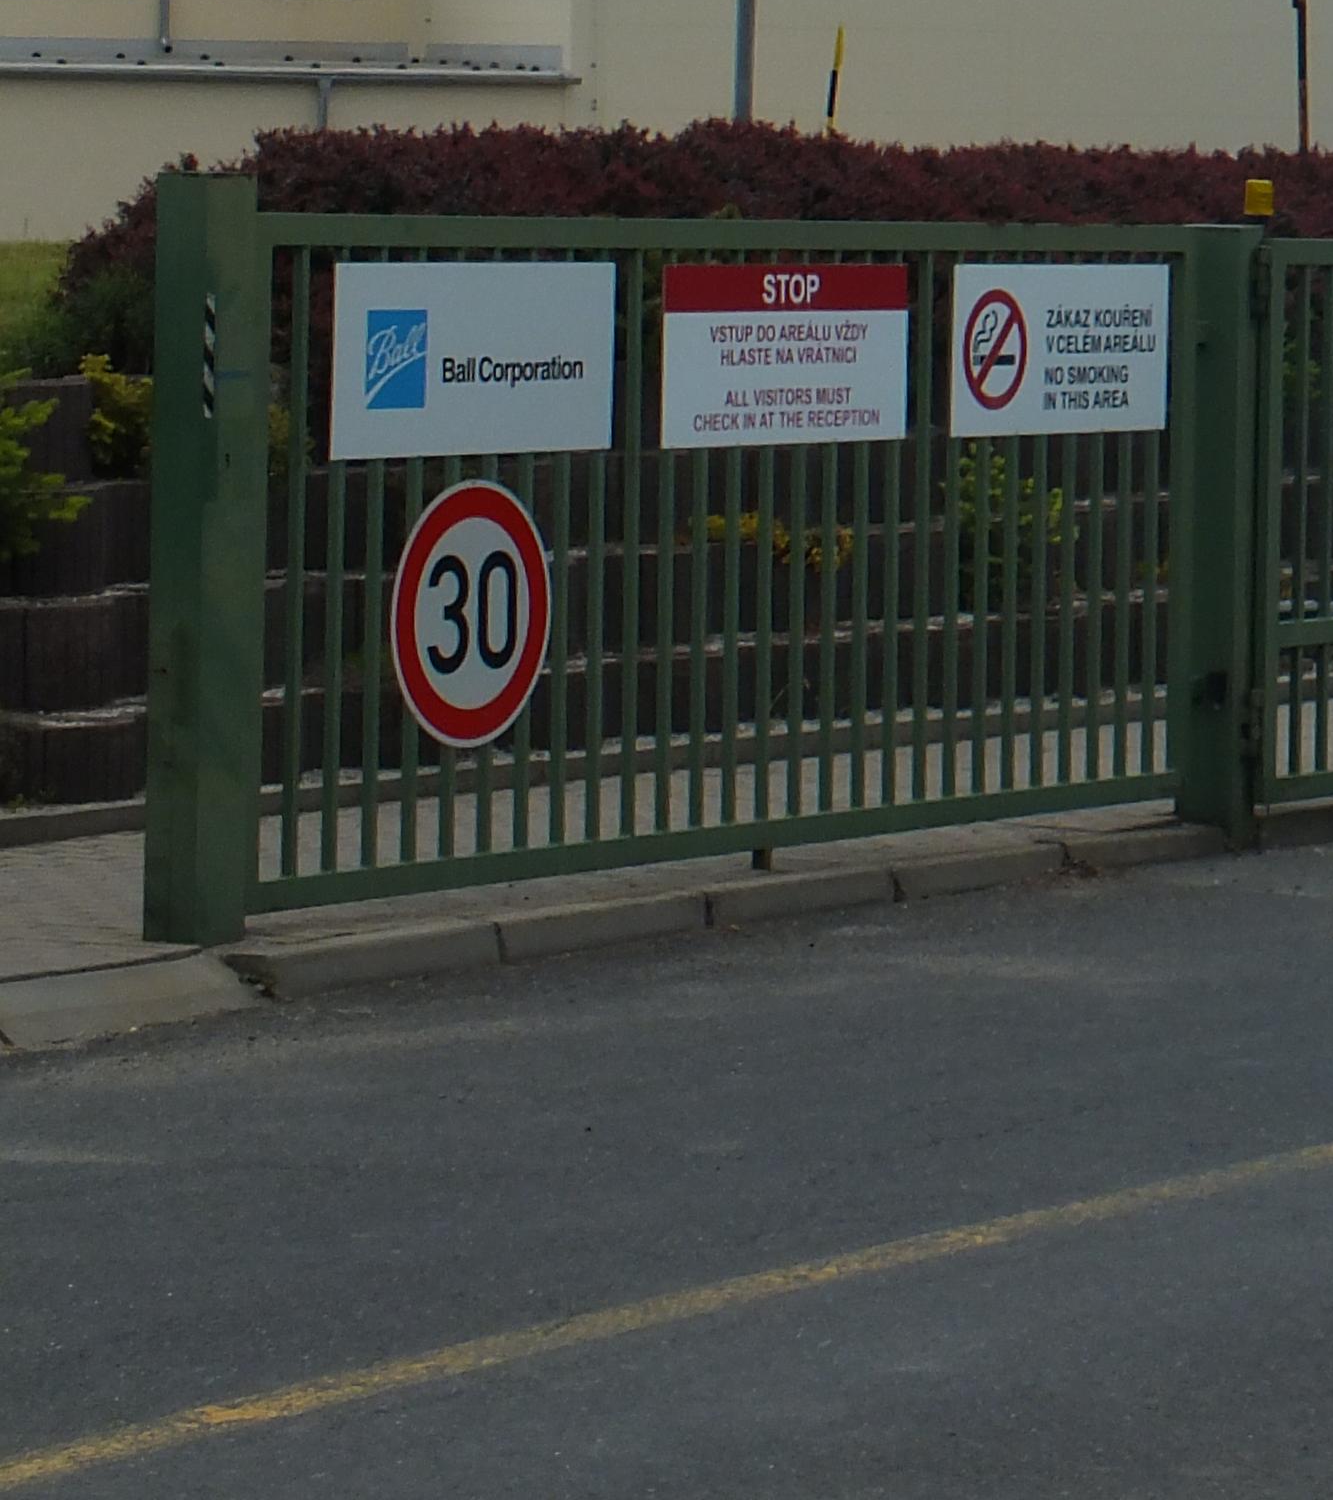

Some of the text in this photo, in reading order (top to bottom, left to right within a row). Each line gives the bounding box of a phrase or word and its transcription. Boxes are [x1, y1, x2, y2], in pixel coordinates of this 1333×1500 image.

[762, 273, 821, 304] STOP
[1046, 303, 1154, 328] ZÁKAZ KOUŘENÍ
[710, 319, 869, 343] VSTUP DO AREÁLU VŽDY
[1046, 329, 1157, 354] V CELÉM AREÁLU
[367, 321, 428, 386] Ball
[720, 342, 858, 367] HLASTE NA VRÁTNICI
[441, 355, 585, 388] Ball Corporation
[1044, 365, 1129, 386] NO SMOKING
[724, 387, 852, 408] ALL VISITORS MUST
[1043, 389, 1129, 411] IN THIS AREA
[693, 408, 881, 433] CHECK IN AT THE RECEPTION
[427, 550, 518, 675] 30
